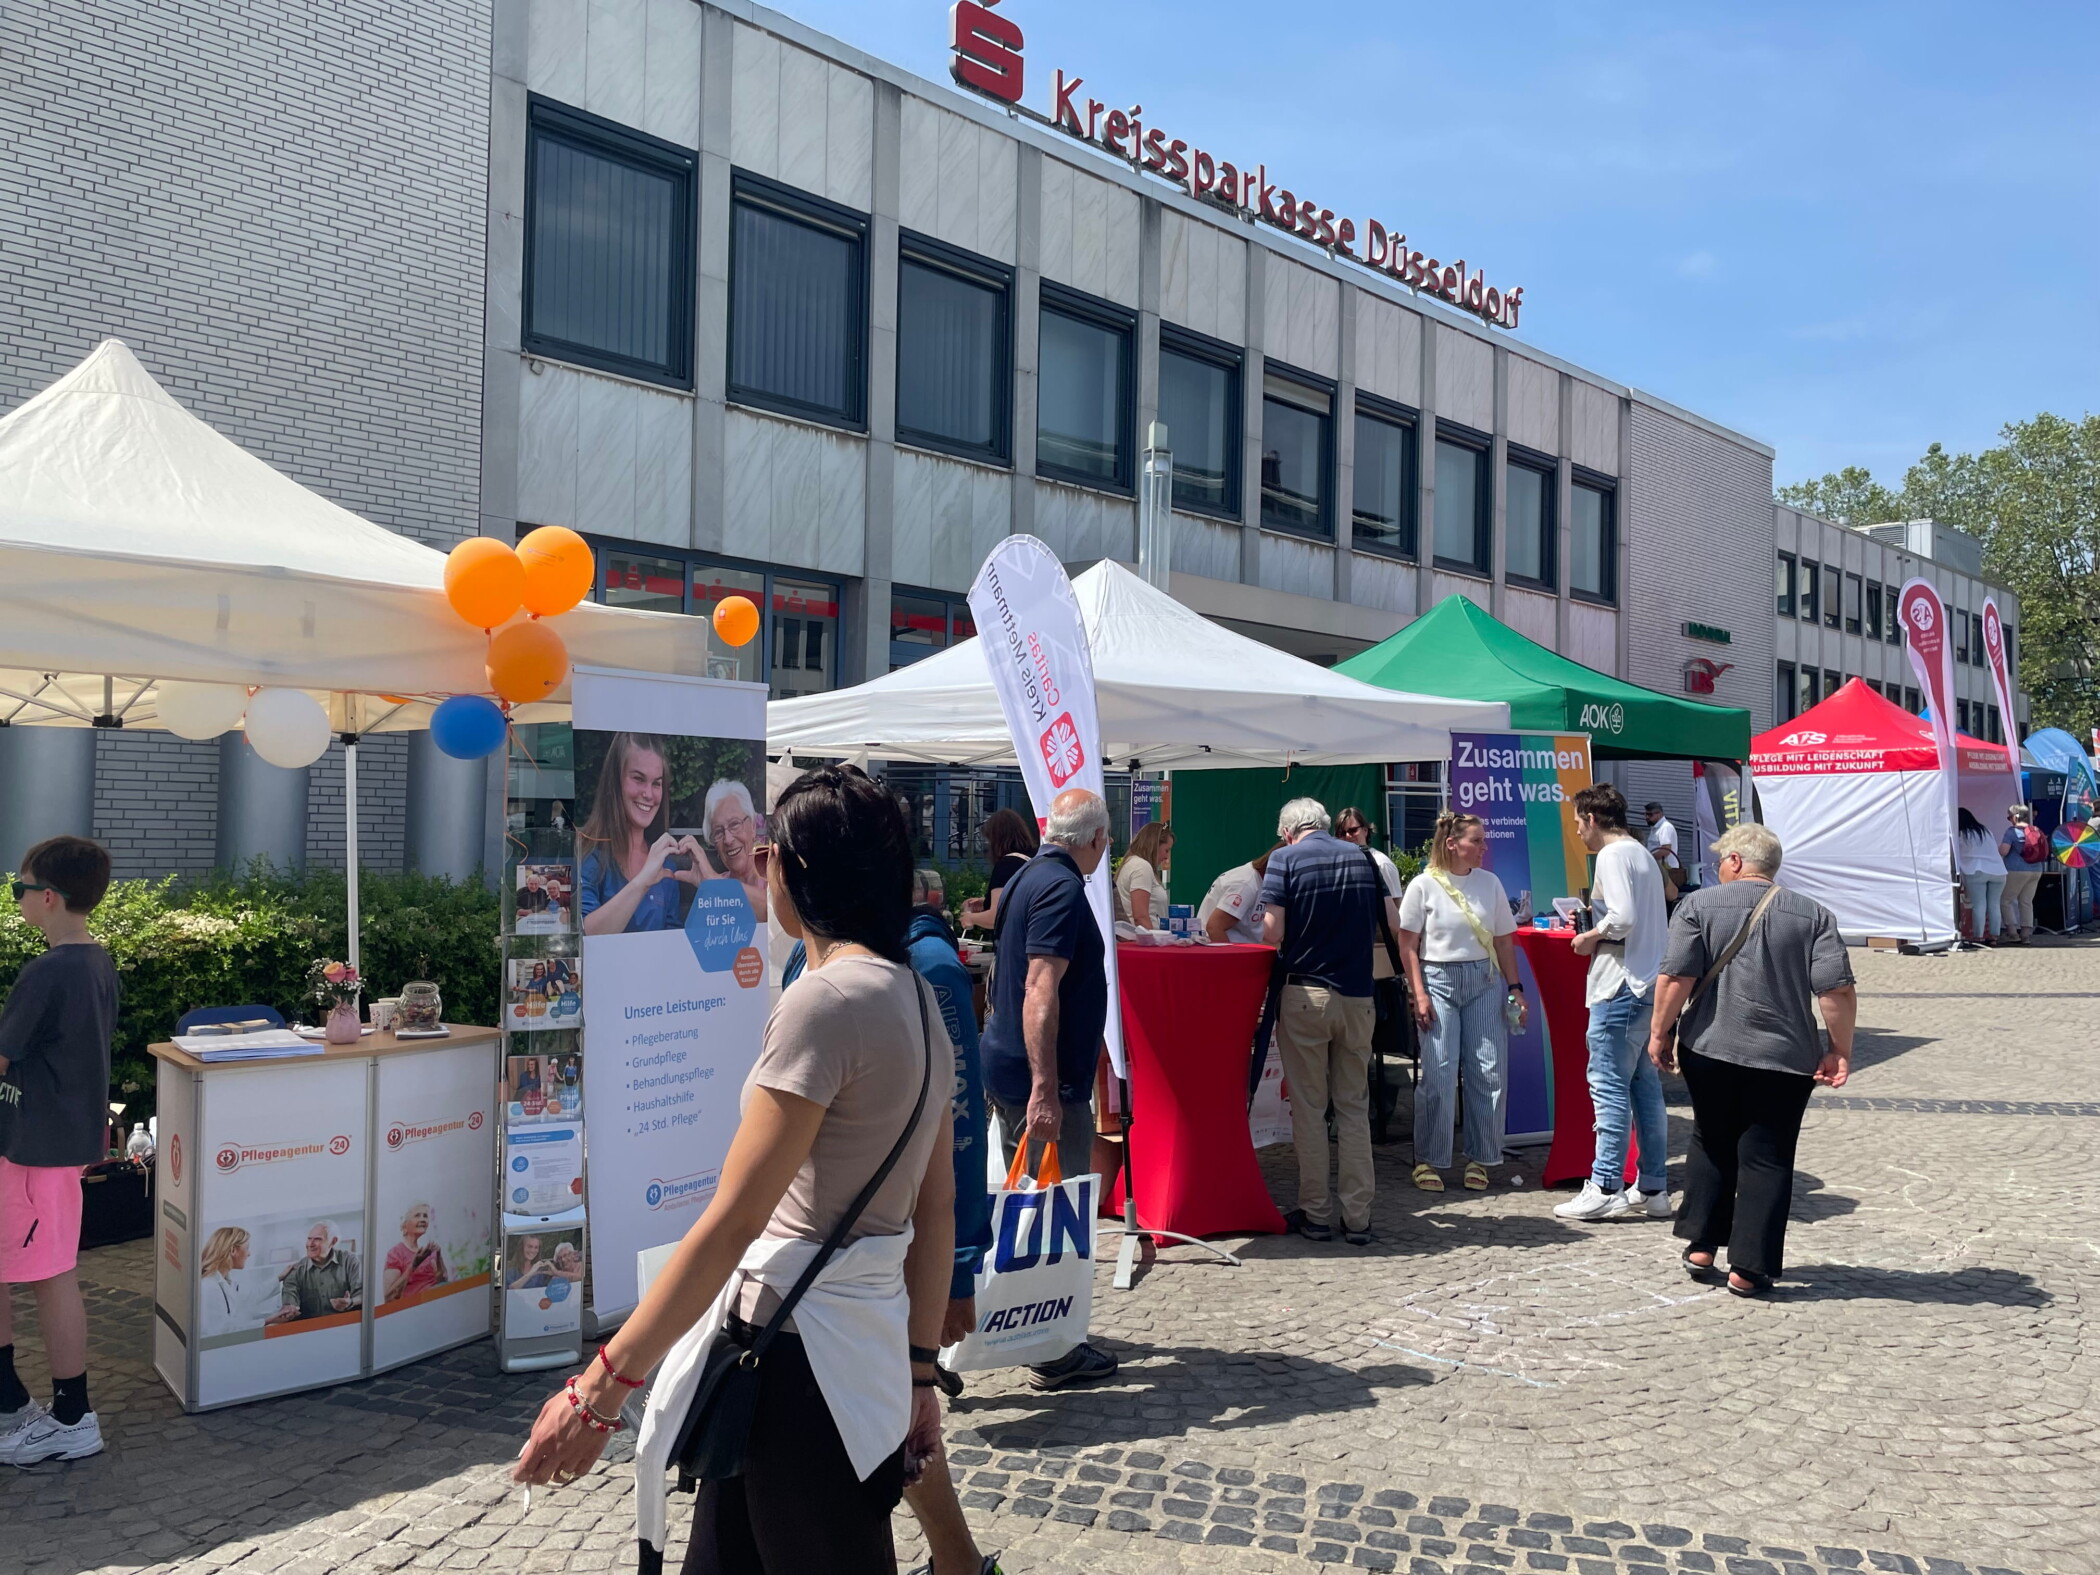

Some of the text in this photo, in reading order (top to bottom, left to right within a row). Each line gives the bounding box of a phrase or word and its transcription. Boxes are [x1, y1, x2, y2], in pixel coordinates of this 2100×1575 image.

[1051, 68, 1524, 329] Kreissparkasse Düsseldorf
[1580, 704, 1609, 729] AOK
[1458, 742, 1584, 770] Zusammen
[1786, 753, 1805, 762] MIT
[1807, 751, 1885, 762] LEIDENSCHAFT
[1752, 761, 1885, 773] USBILDUNG MIT ZUKUNFT
[1134, 783, 1169, 793] Zusammen
[1460, 776, 1571, 808] geht was.
[1491, 816, 1527, 826] verbindet
[1485, 830, 1515, 839] ationen
[698, 896, 744, 909] Bei Ihnen,
[706, 914, 736, 926] für Sie
[704, 927, 728, 951] durch
[624, 997, 726, 1020] Unsere Leistungen:
[632, 1027, 699, 1047] Pflegeberatung
[632, 1050, 687, 1069] Grundpflege
[633, 1067, 715, 1091] Behandlungspflege
[633, 1090, 695, 1113] Haushaltshilfe
[405, 1120, 466, 1140] Pflegeagentur
[652, 1117, 669, 1131] Std.
[241, 1143, 326, 1163] Pflegeagentur
[663, 1175, 717, 1197] Pflegeagentur
[984, 1296, 1074, 1333] ACTION
